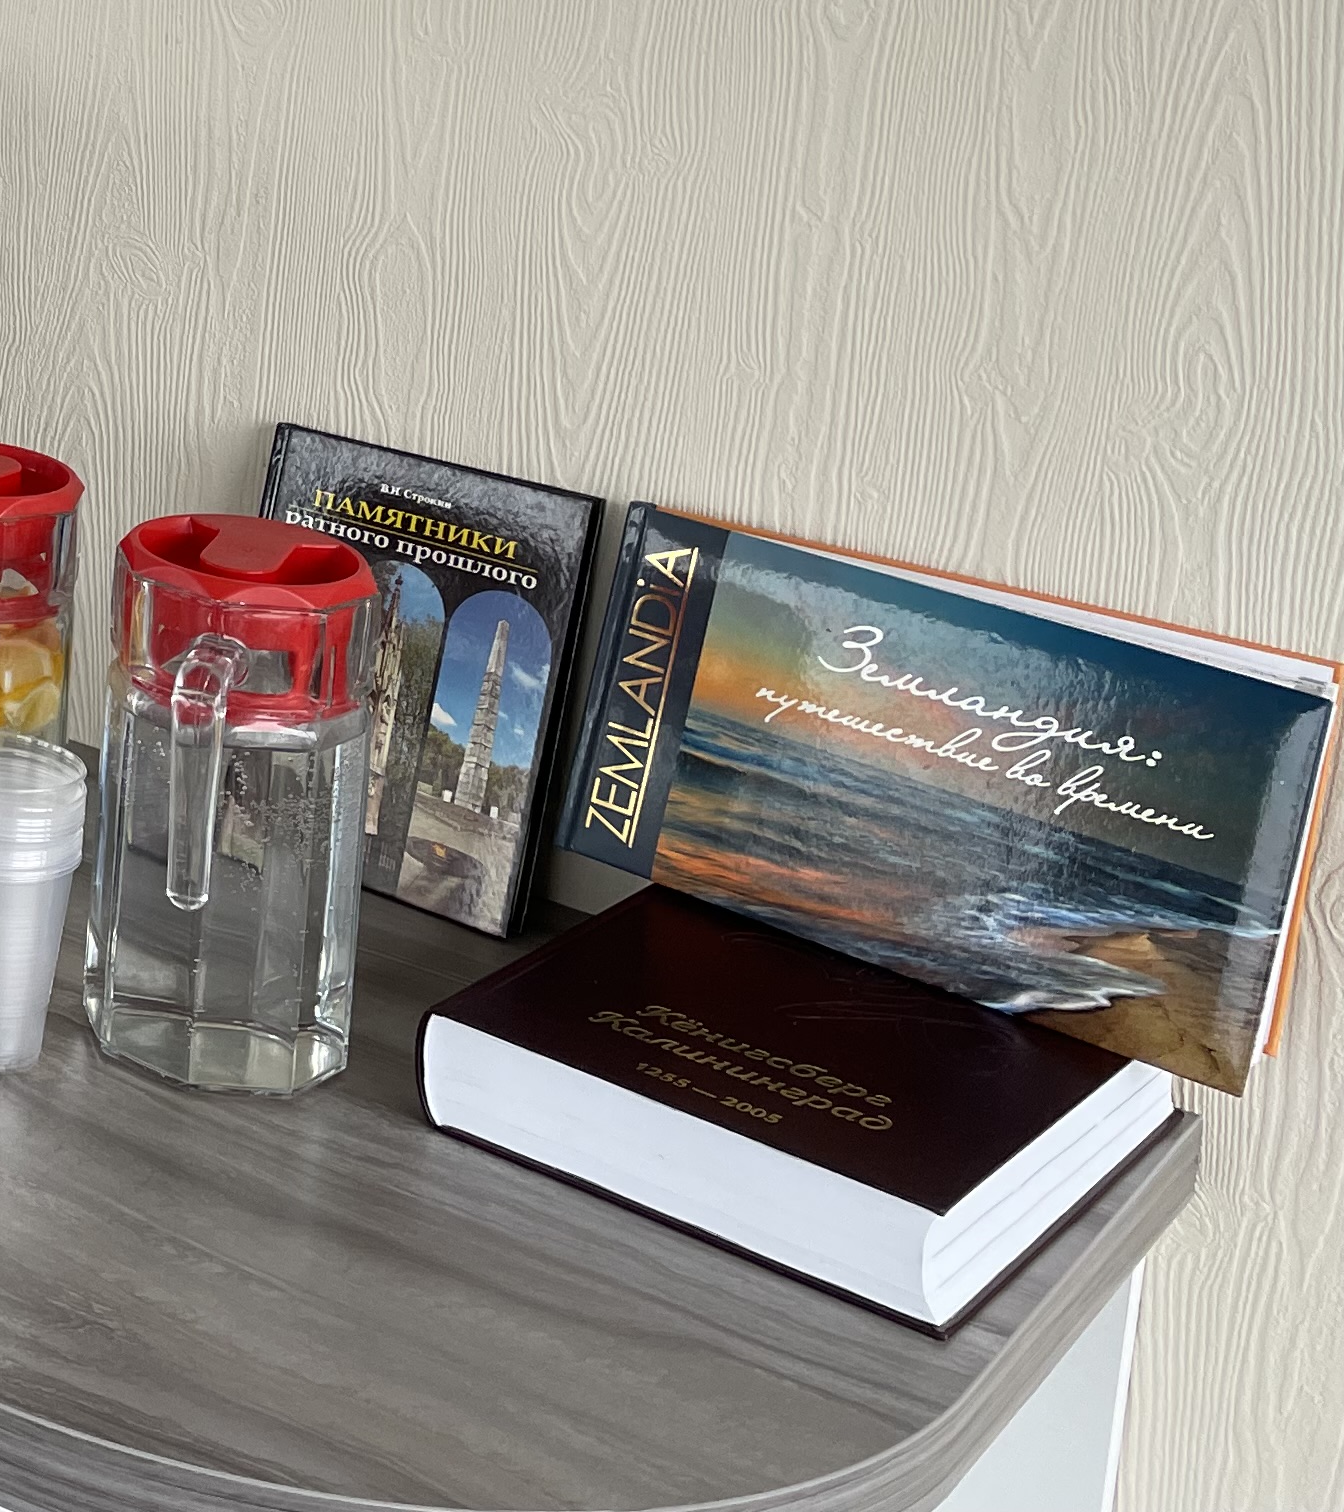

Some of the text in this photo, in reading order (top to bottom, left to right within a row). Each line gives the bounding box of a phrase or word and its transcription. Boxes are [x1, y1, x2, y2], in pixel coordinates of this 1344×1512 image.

[313, 488, 519, 560] ПАМЯТНИКИ
[395, 539, 538, 590] прошлого
[817, 624, 1164, 768] Земландия:
[755, 687, 1215, 841] путешествие во времени
[588, 1011, 894, 1130] Калининград
[635, 1062, 692, 1089] 1255
[719, 1095, 784, 1124] 2005
[636, 1005, 893, 1107] Кёнигсберг
